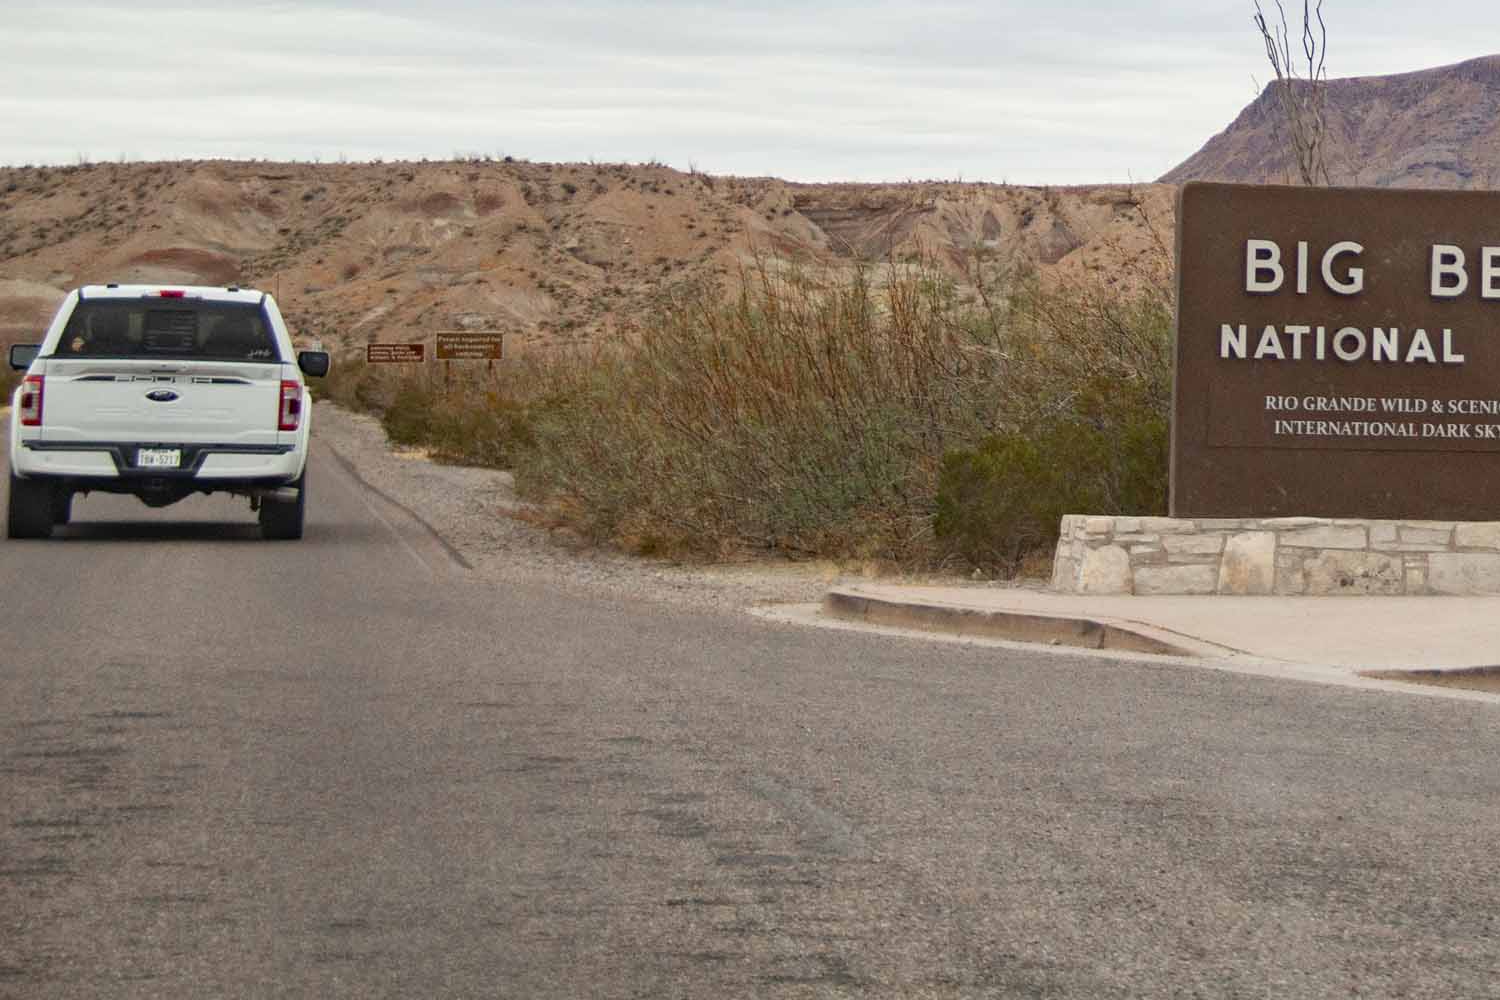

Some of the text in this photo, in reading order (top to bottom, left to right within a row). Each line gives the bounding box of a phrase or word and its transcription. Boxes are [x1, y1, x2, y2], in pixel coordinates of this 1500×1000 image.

[1246, 239, 1364, 294] BIG
[1221, 324, 1465, 363] NATIONAL
[1265, 395, 1299, 410] RIO
[1302, 396, 1377, 412] GRANDE
[1380, 398, 1428, 413] WILD
[1431, 399, 1443, 414] &
[1274, 420, 1418, 437] INTERNATIONAL
[1422, 423, 1471, 438] DARK
